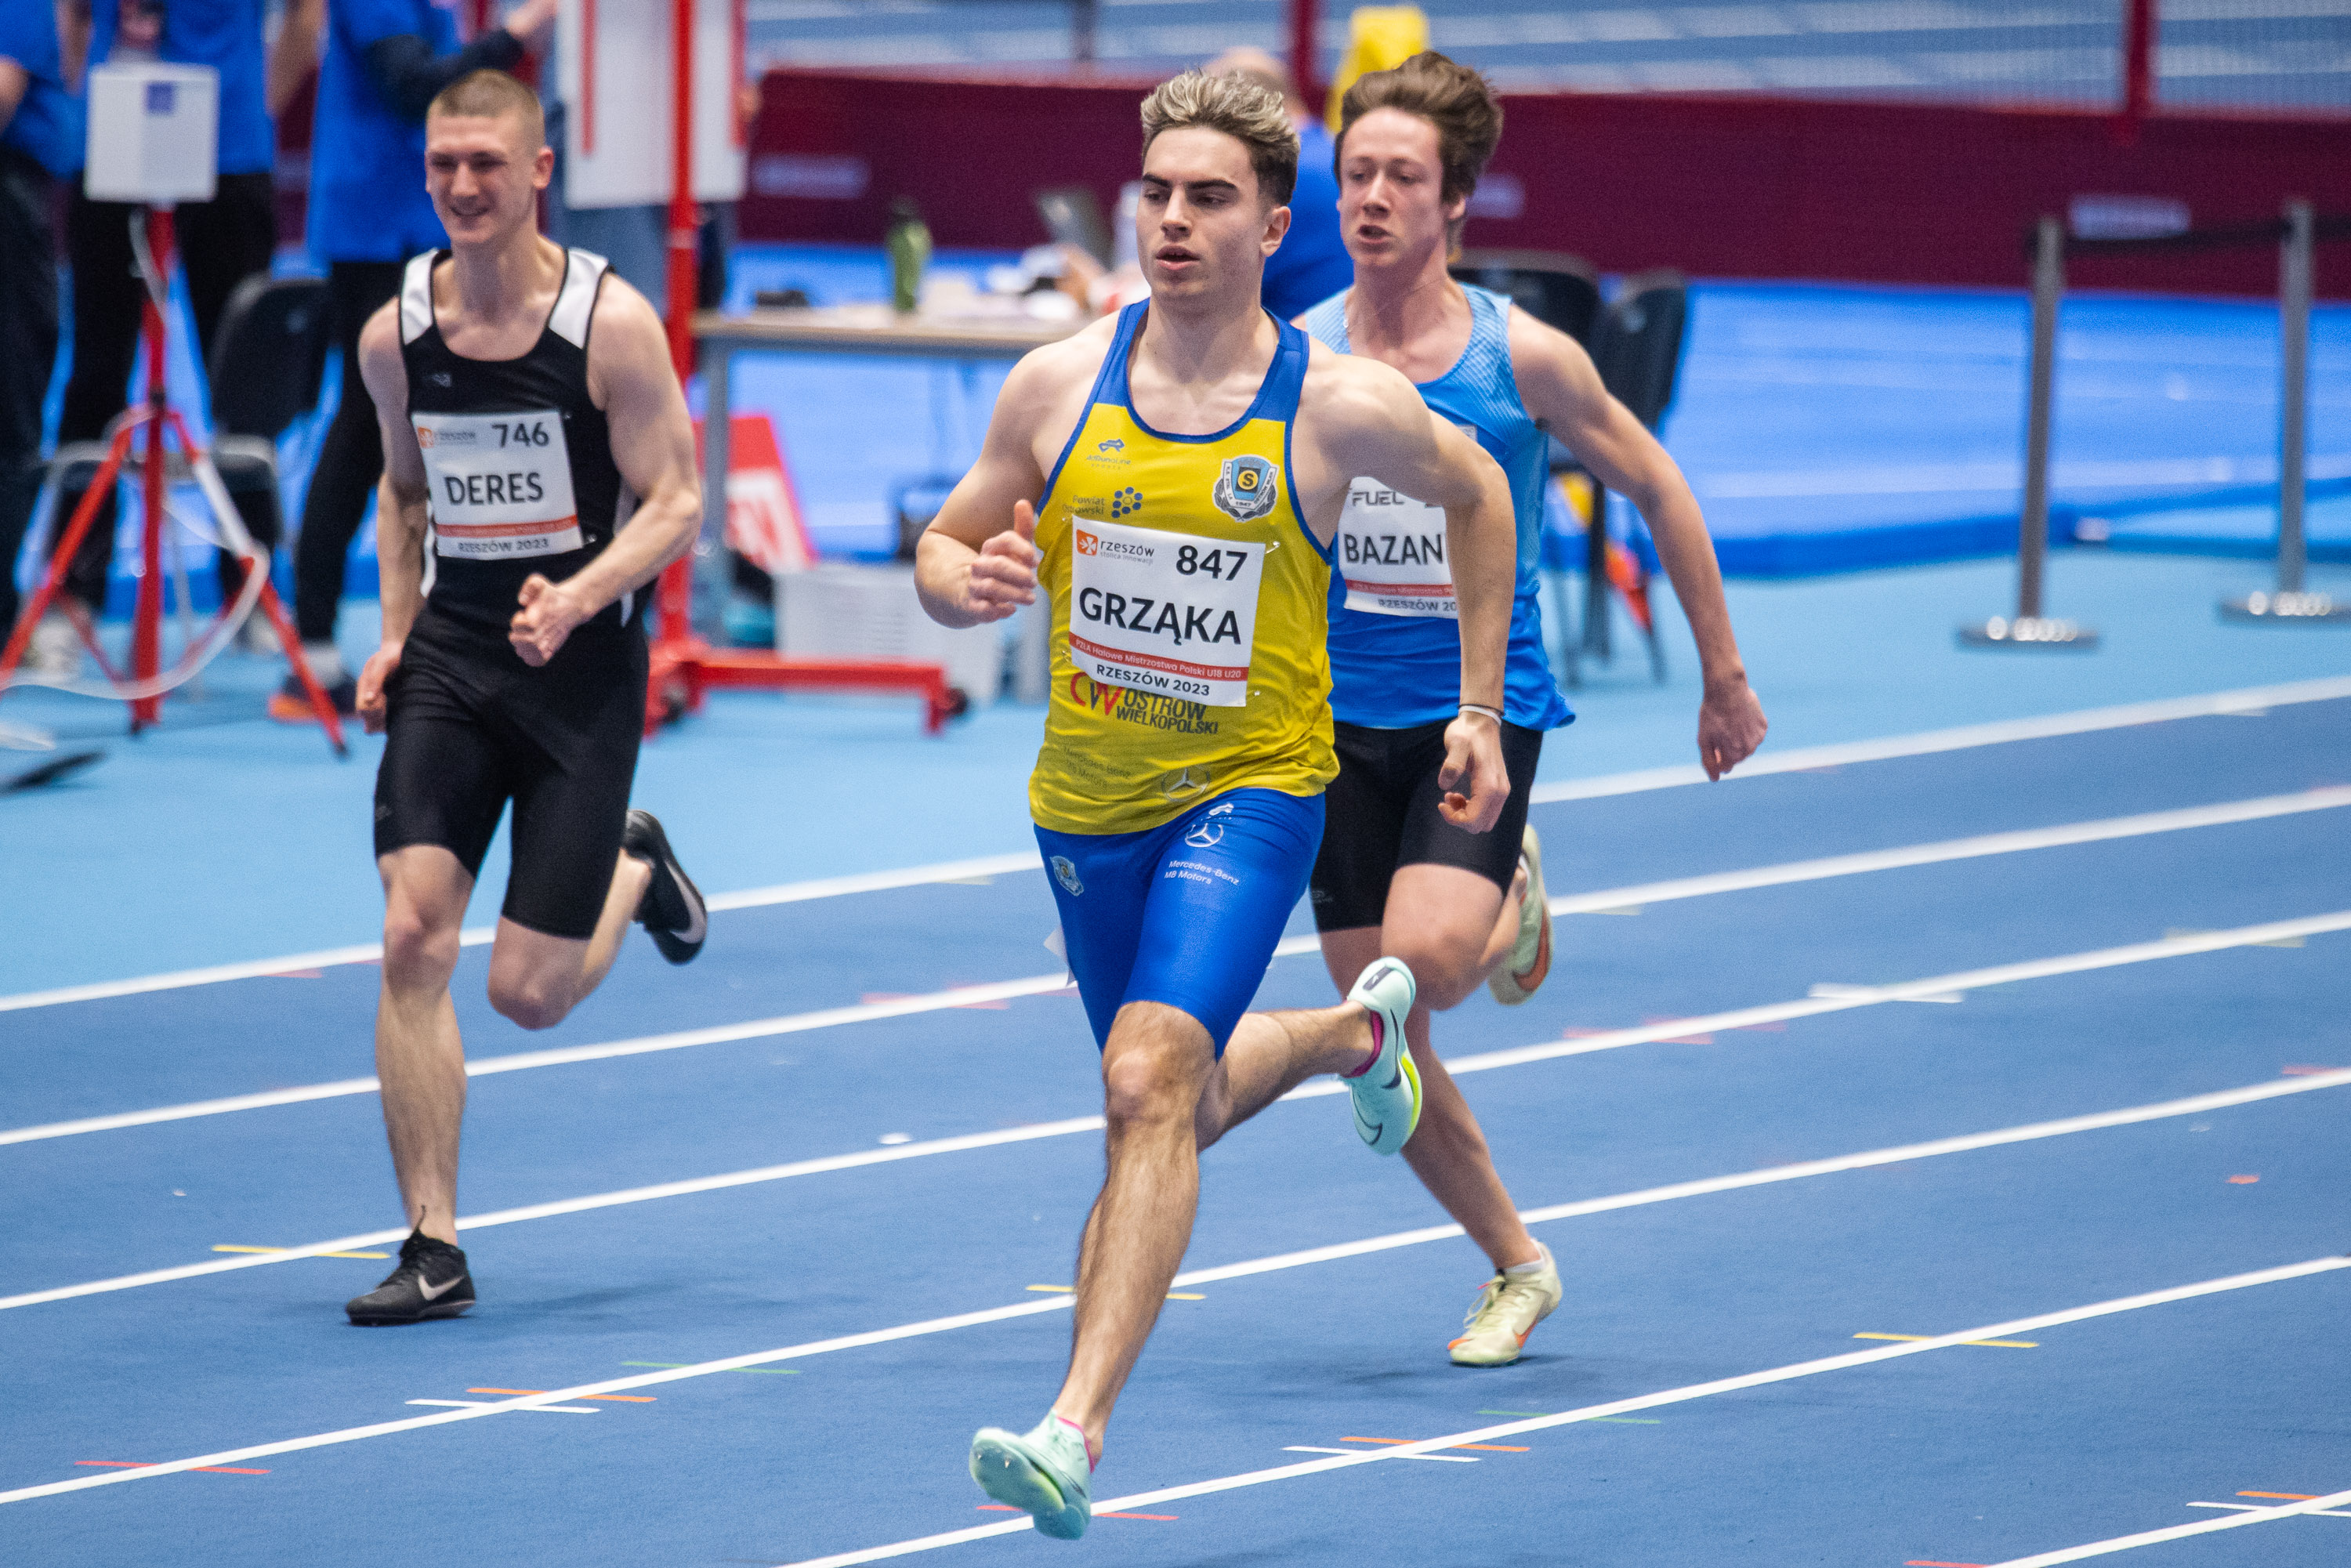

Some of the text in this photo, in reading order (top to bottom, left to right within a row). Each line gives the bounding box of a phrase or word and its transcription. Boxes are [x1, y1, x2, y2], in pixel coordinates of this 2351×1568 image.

[491, 422, 549, 447] 746
[444, 472, 544, 505] DERES
[1242, 473, 1255, 487] S
[1352, 491, 1405, 507] FUEL
[458, 538, 549, 553] RZESZÓW 2023
[1100, 541, 1155, 557] rzeszów
[1343, 534, 1444, 565] BAZAN
[1176, 545, 1248, 581] 847
[1079, 587, 1242, 646] GRZĄKA
[1378, 599, 1439, 611] RZESZÓW
[1092, 646, 1123, 661] Halowe
[1125, 654, 1178, 671] Mistrzostwa
[1179, 664, 1204, 676] Polski
[1207, 668, 1223, 678] U18
[1096, 664, 1210, 696] RZESZÓW 2023
[1116, 705, 1219, 734] WIELKOPOLSKI
[1164, 870, 1212, 885] MB Motors
[1168, 860, 1240, 886] Mercedes-Benz
